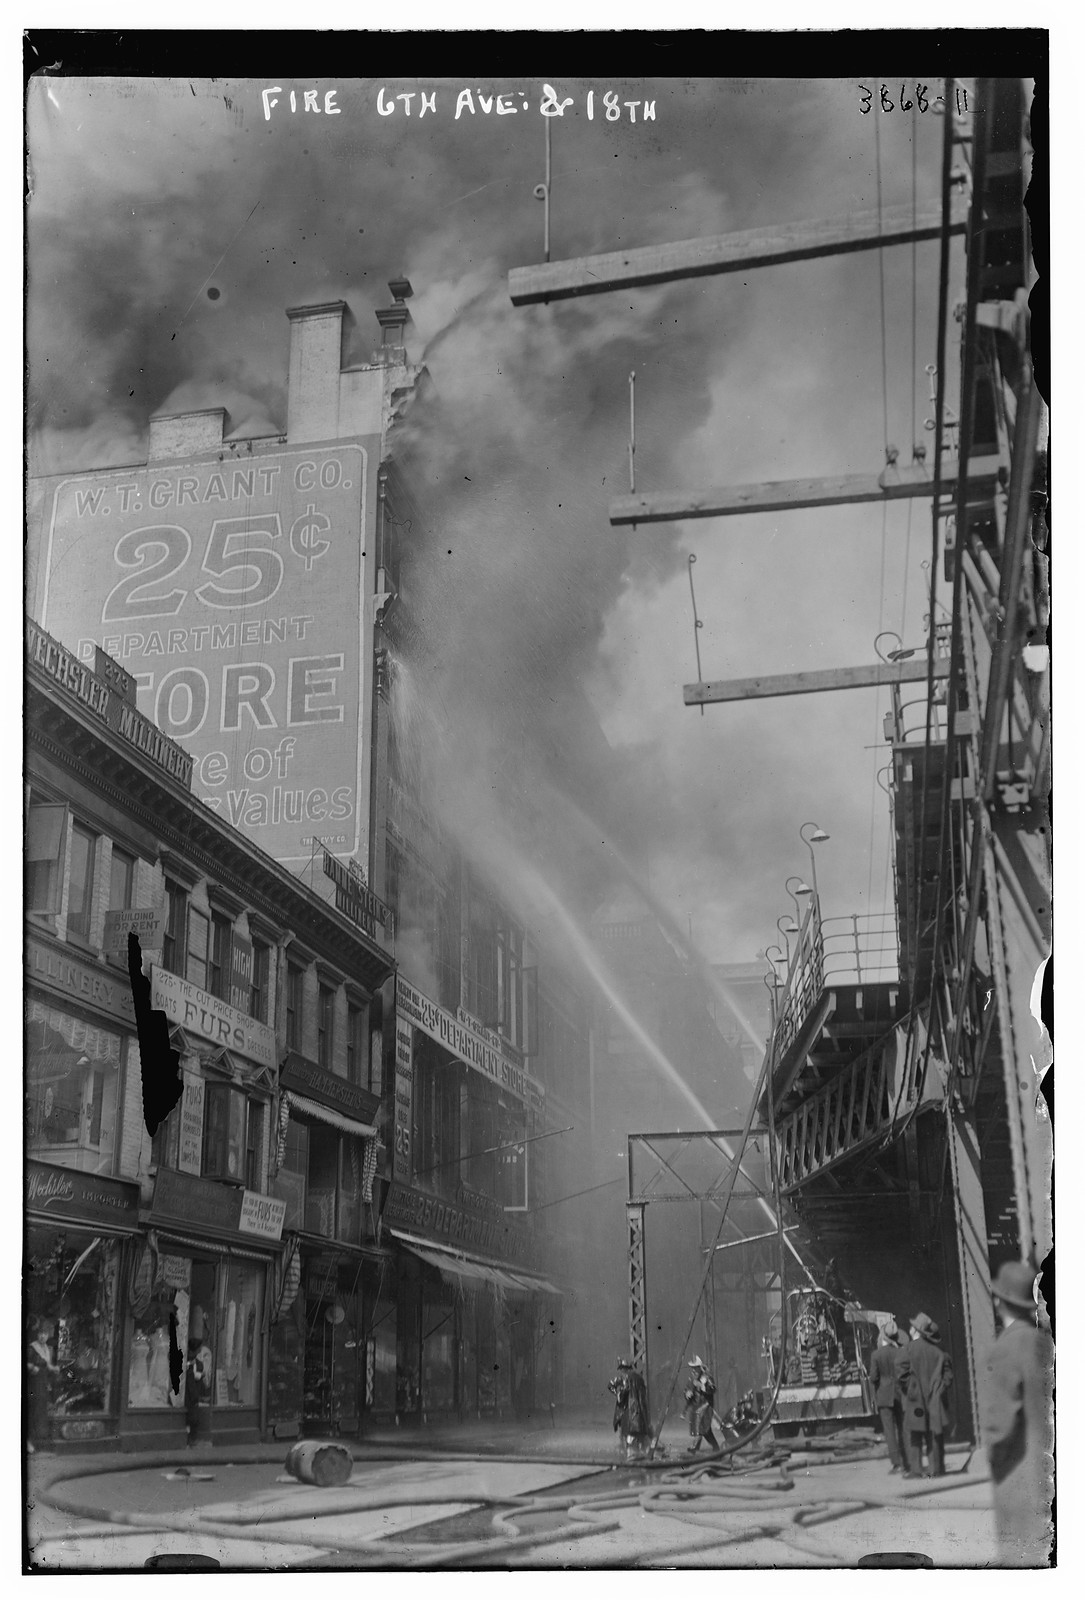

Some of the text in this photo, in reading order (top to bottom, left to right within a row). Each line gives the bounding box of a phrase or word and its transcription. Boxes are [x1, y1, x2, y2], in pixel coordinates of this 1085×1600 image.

[149, 465, 281, 511] GRANT
[293, 459, 353, 493] CO.
[101, 503, 332, 624] 25¢
[76, 614, 315, 665] DEPARTMENT
[104, 660, 130, 692] 273
[134, 652, 345, 740] ORE
[118, 704, 193, 788] MILLINERY
[243, 736, 297, 782] of
[227, 786, 353, 828] Values
[115, 911, 154, 922] BUILDING
[131, 920, 160, 931] RENT
[27, 950, 114, 1005] LLINERY
[233, 946, 251, 979] HIGH
[155, 992, 177, 1014] COATS
[180, 981, 193, 998] THE
[196, 991, 210, 1007] CUT
[213, 1001, 233, 1020] PRICE
[236, 1013, 255, 1030] SHOP
[181, 999, 245, 1050] FURS
[248, 1038, 271, 1061] DRESSES
[440, 1014, 498, 1078] DEPARTMENT
[502, 1061, 526, 1096] STORE
[186, 1084, 203, 1106] FURS
